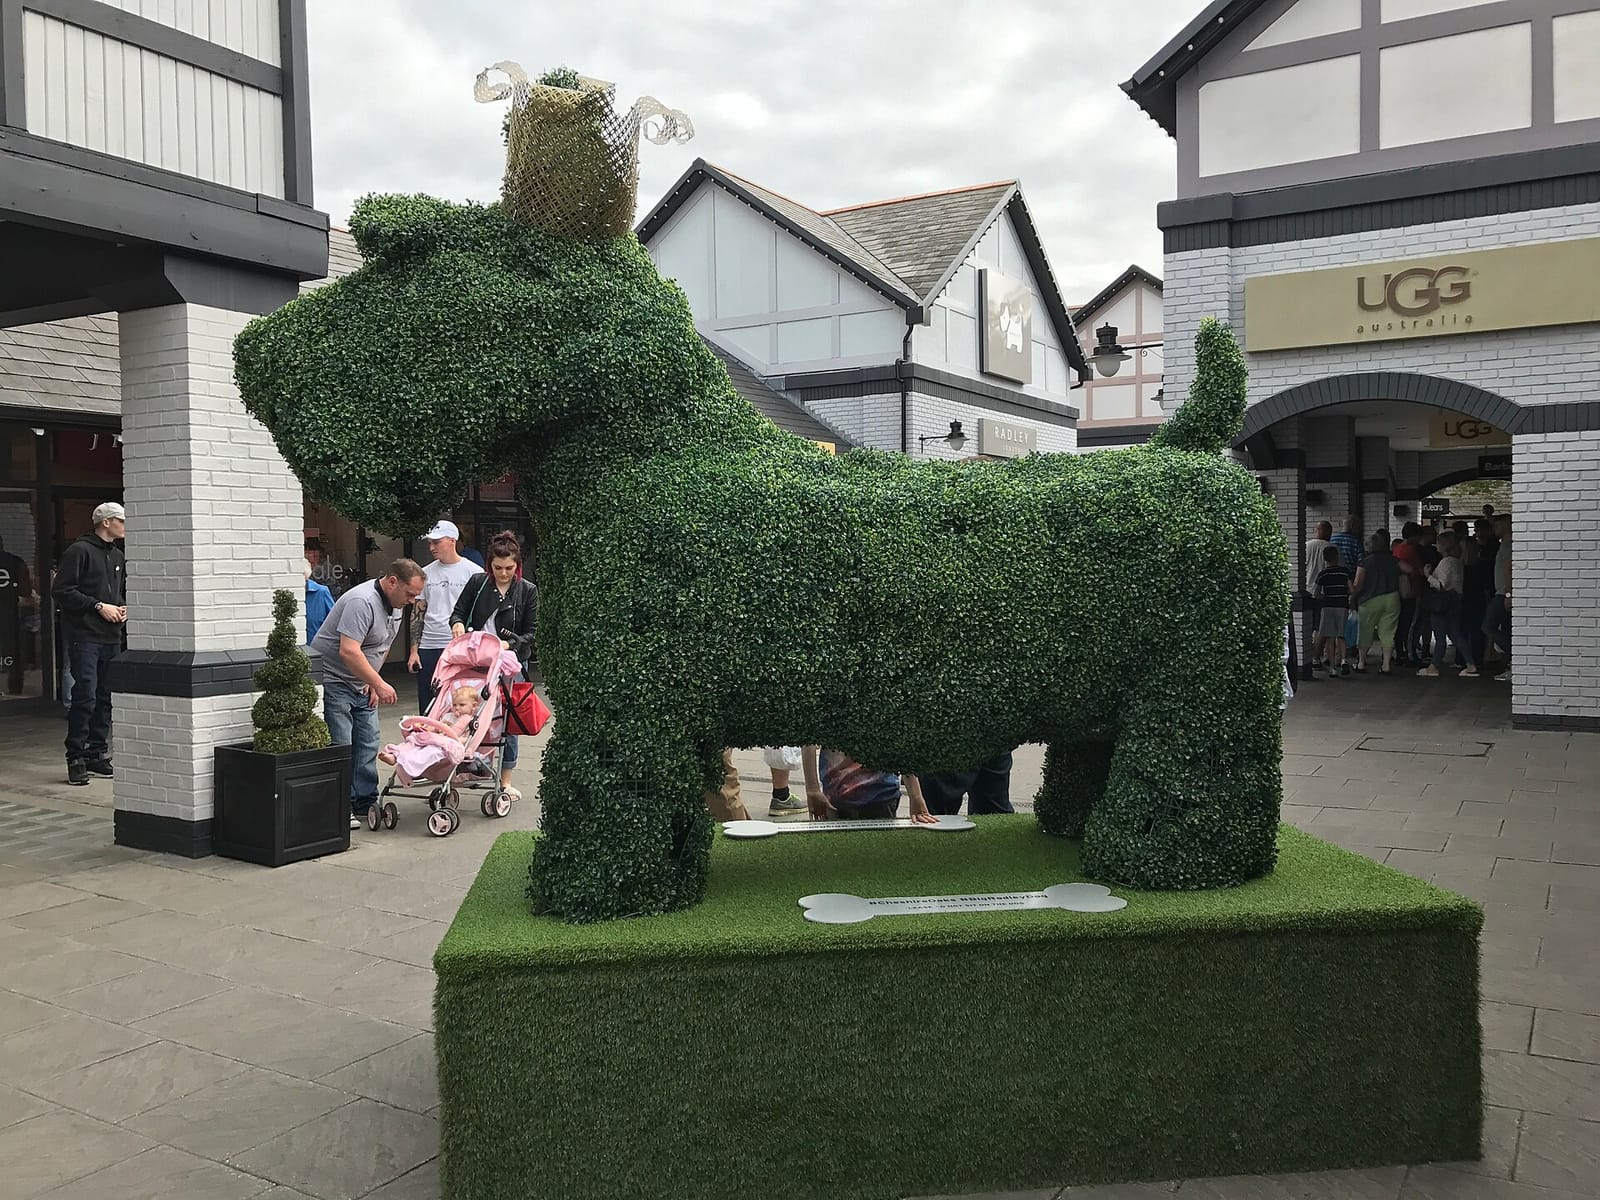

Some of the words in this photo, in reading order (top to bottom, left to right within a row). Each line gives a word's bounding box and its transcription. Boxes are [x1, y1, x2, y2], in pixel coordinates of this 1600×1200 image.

[1357, 266, 1472, 316] UGG
[1356, 312, 1473, 334] australia
[993, 425, 1029, 444] RADLEY
[1445, 421, 1492, 438] UGG
[960, 894, 1049, 902] #BigRadleyDog
